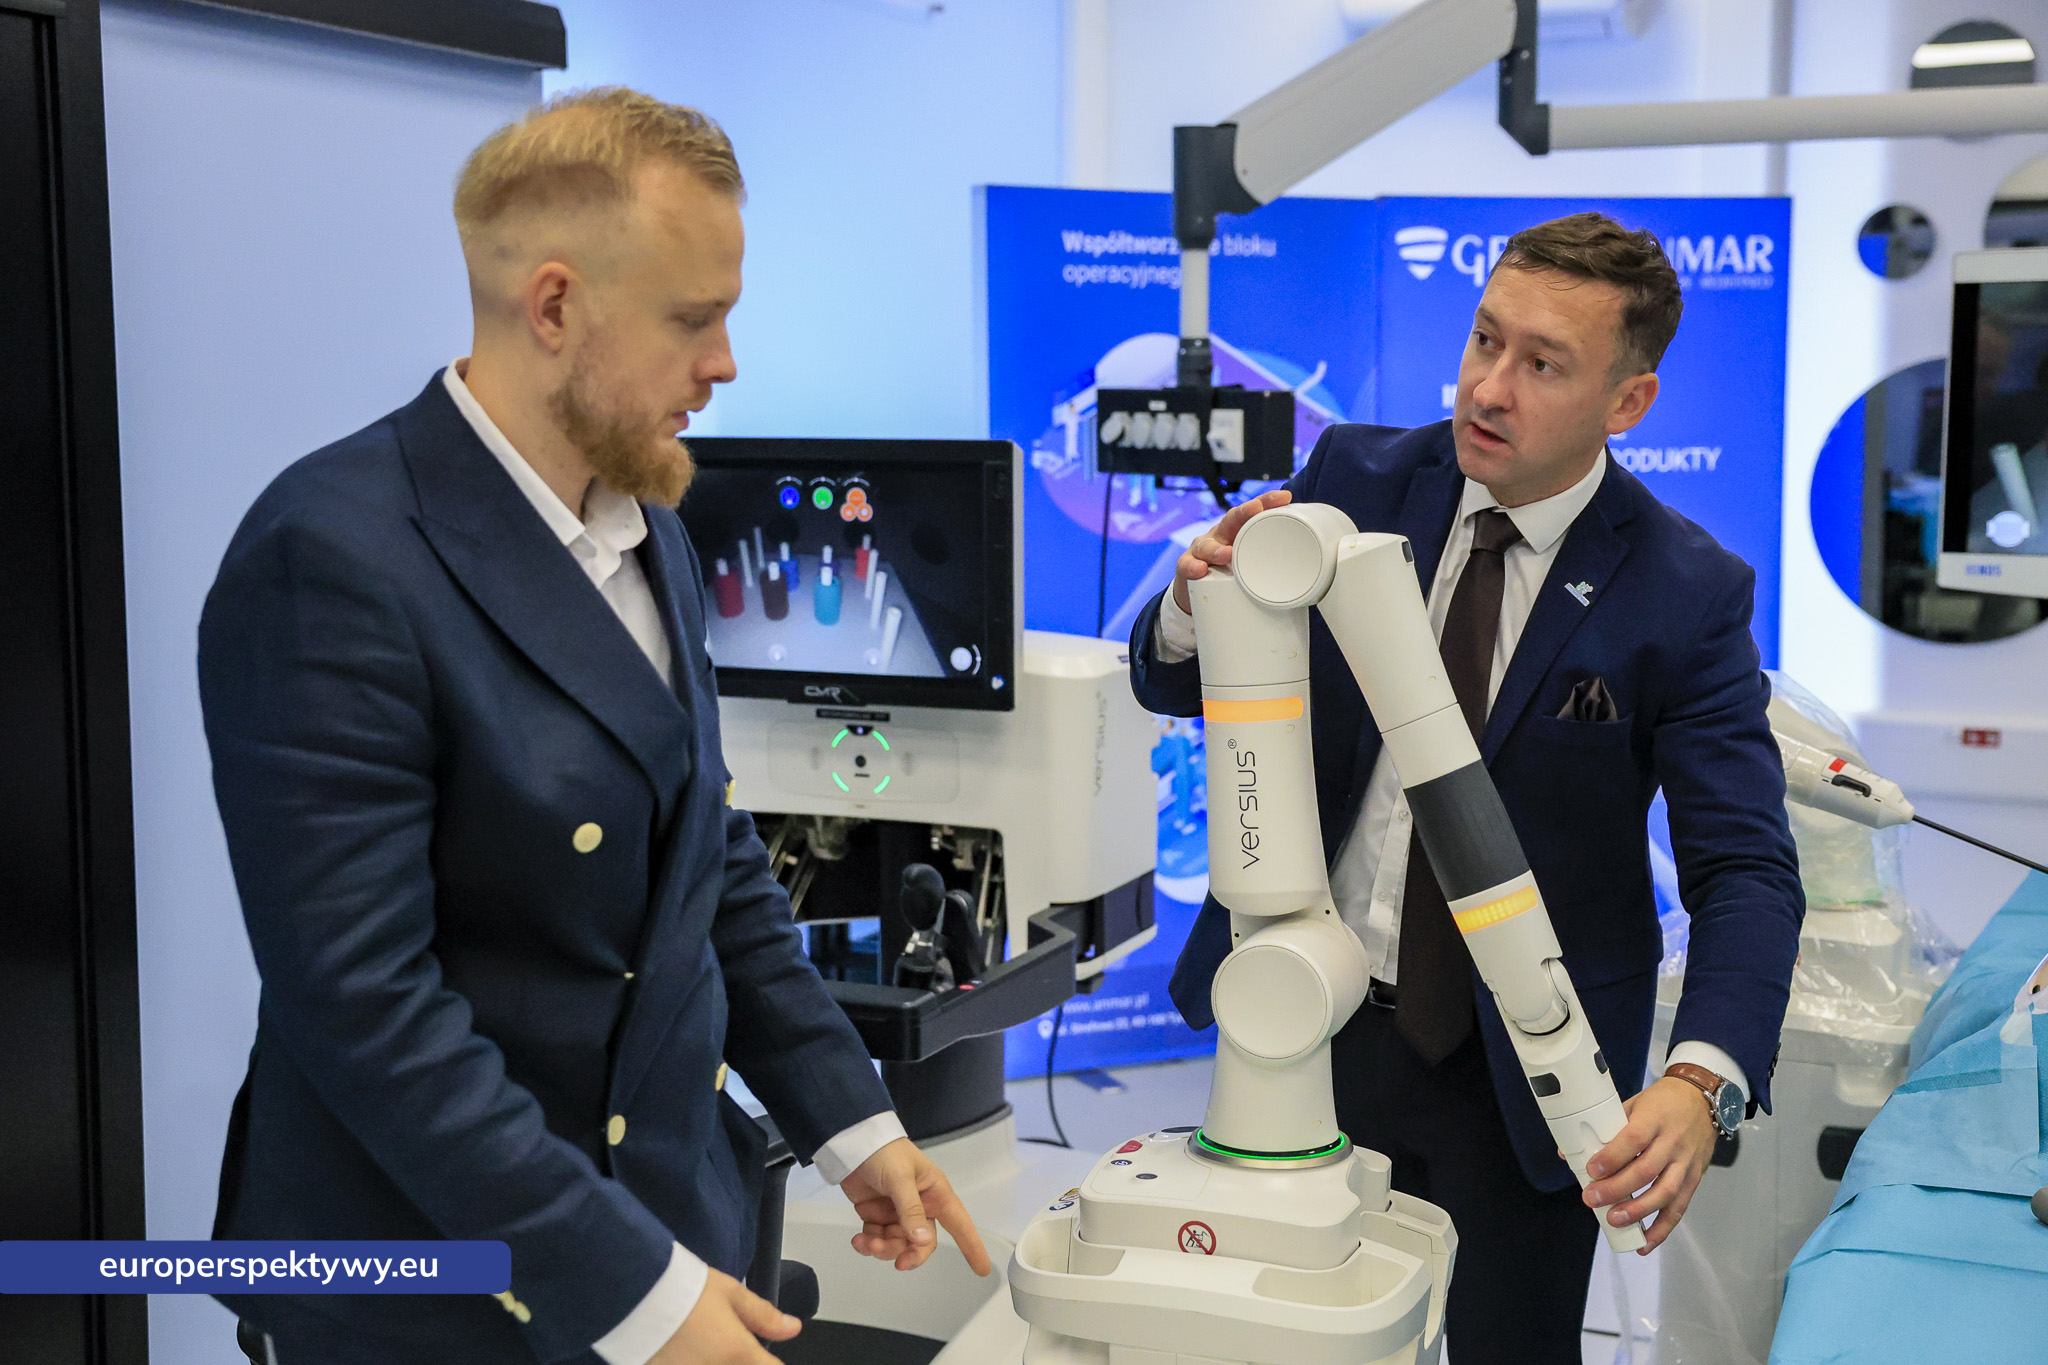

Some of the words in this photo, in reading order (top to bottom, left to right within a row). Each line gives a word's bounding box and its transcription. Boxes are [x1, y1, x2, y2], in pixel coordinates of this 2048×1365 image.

[1061, 229, 1221, 258] Współtworze
[1223, 233, 1277, 257] bloku
[1062, 261, 1181, 289] operacyjneg
